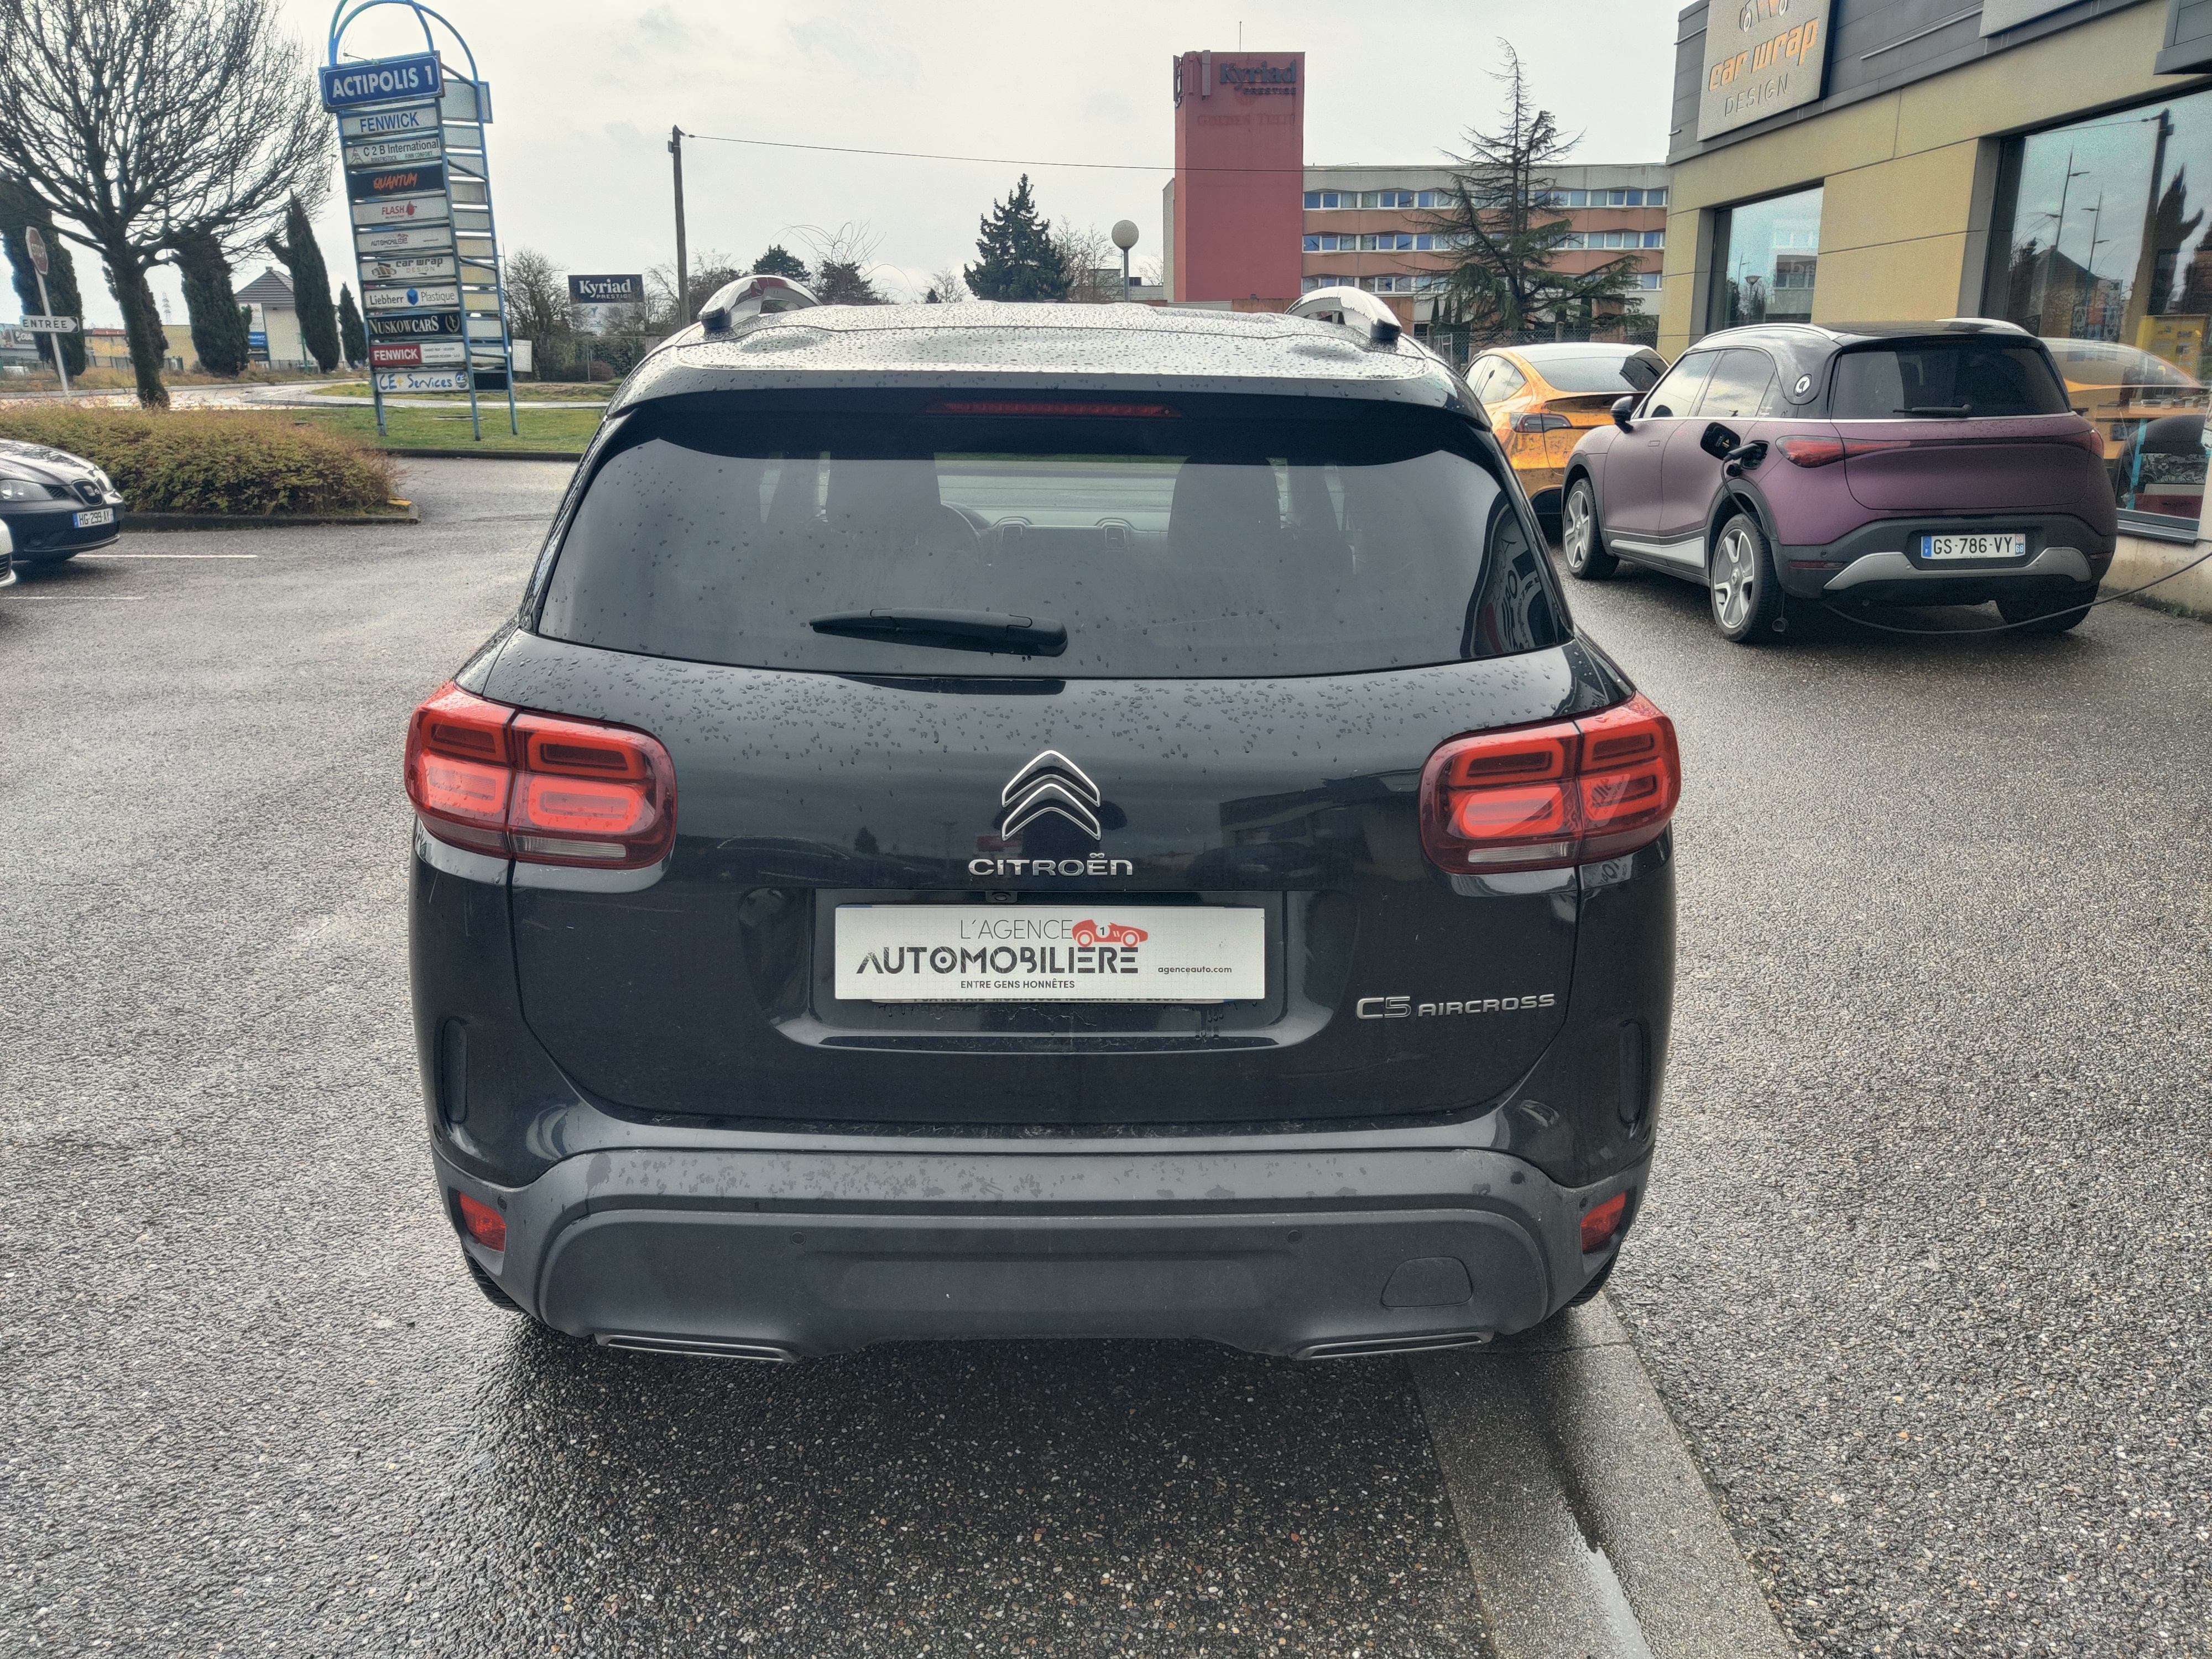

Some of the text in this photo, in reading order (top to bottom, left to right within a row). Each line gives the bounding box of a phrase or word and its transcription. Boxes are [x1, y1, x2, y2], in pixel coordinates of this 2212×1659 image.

[1708, 17, 1819, 92] car wrap
[332, 65, 433, 98] ACTIPOLIS 1
[1220, 59, 1296, 90] Kyriad
[1724, 73, 1788, 117] DESIGN
[359, 111, 420, 133] FENWICK
[363, 138, 439, 156] C 2 B International
[373, 173, 418, 190] QUANTUM
[382, 205, 405, 215] FLASH
[396, 258, 443, 268] car wrap
[578, 278, 632, 298] Kyriad
[369, 291, 455, 305] Liebherr Plastique
[23, 318, 68, 329] ENTRÉE
[368, 315, 440, 335] NUSKOWCARS
[373, 348, 420, 361] FENWICK
[379, 373, 453, 390] CE Services
[1933, 536, 2013, 555] GS-786-VY
[2015, 544, 2024, 553] 68
[968, 852, 1133, 877] CITROËN
[961, 919, 1073, 939] L'AGENCE
[1099, 926, 1105, 936] 1
[1157, 966, 1232, 975] agenceauto.com
[960, 978, 1075, 989] ENTRE GENS HONNÊTES
[1355, 993, 1556, 1020] C5 AIRCROSS
